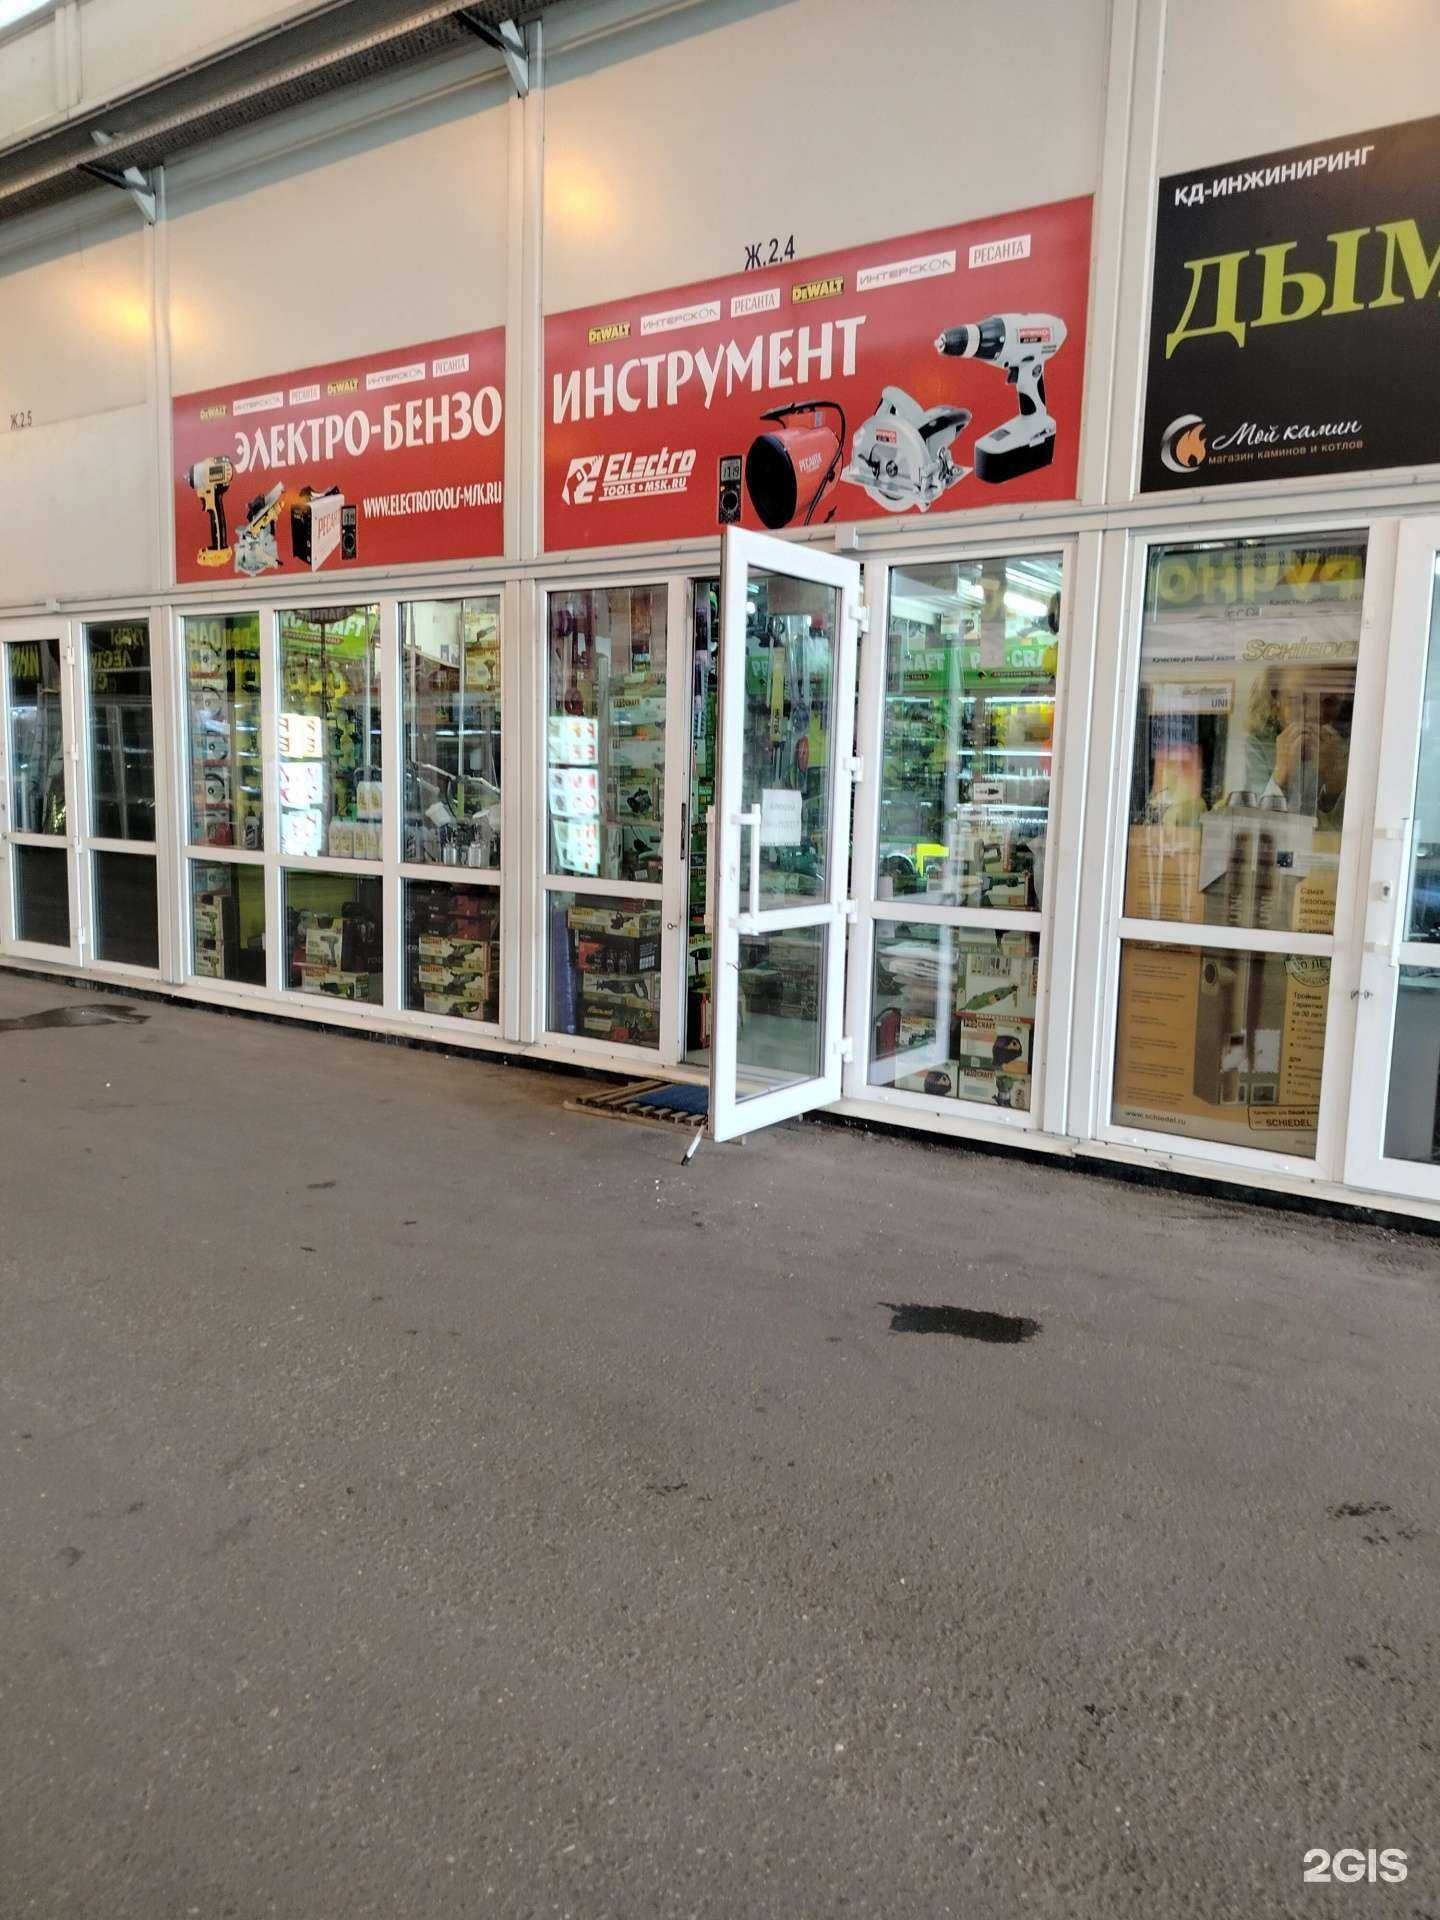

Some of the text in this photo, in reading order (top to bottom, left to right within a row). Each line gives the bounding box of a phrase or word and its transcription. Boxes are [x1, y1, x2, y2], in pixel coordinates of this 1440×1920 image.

[1174, 145, 1375, 206] КД-ИНЖИНИРИНГ
[744, 234, 796, 271] Ж.2.4
[973, 239, 1025, 264] РЕСАНТА
[859, 257, 952, 287] ИНТЕРСКОЛ
[733, 292, 776, 314] РЕСАНТА
[552, 314, 867, 425] ИНСТРУМЕНТ
[234, 385, 503, 474] ЭЛЕКТРО-БЕНЗО
[1211, 419, 1363, 451] Мой камин
[1208, 452, 1254, 466] магазин
[1257, 446, 1307, 460] каминов
[1321, 439, 1364, 454] котлов
[363, 480, 502, 519] WWW.ELECTROTOOLS-MSK.RU
